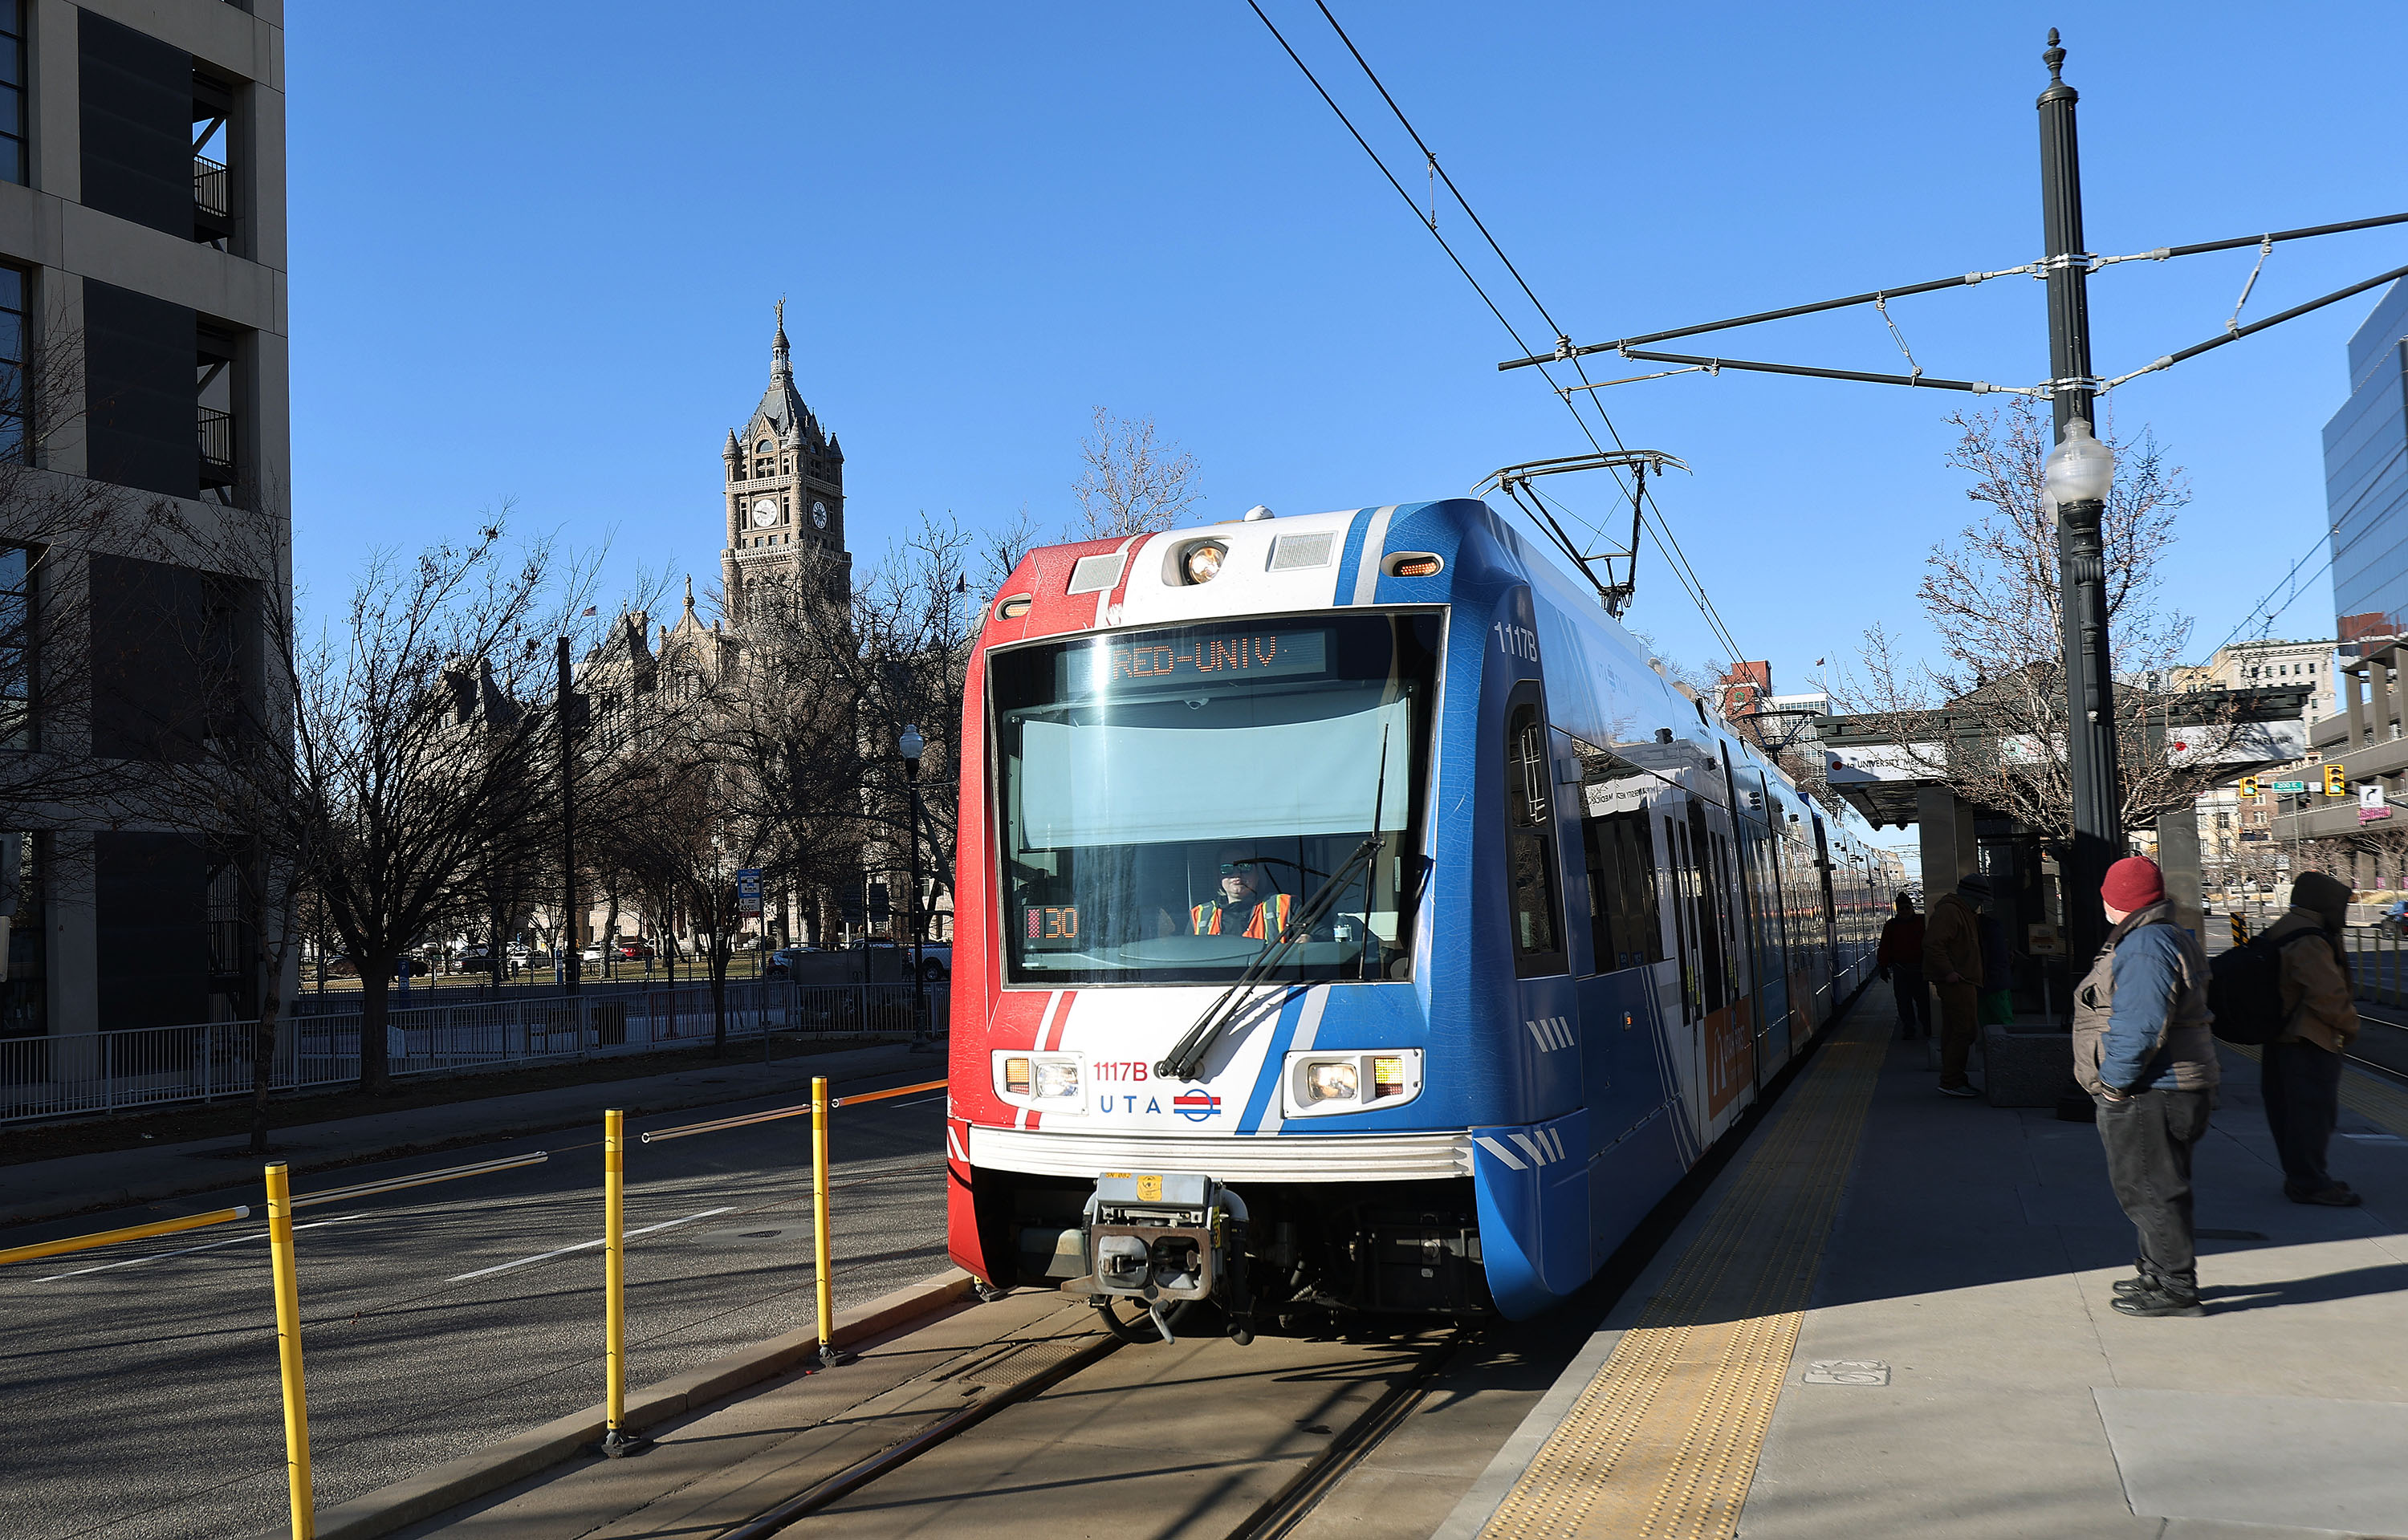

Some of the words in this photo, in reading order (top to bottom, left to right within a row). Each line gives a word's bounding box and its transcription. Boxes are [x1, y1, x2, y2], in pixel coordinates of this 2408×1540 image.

[1494, 621, 1537, 662] 1117B
[1112, 636, 1276, 679] RED-UNIV
[1857, 758, 1900, 768] UNIVERSITY
[1045, 908, 1077, 938] 30
[1093, 1061, 1148, 1081] 1117B
[1100, 1095, 1161, 1114] UTA
